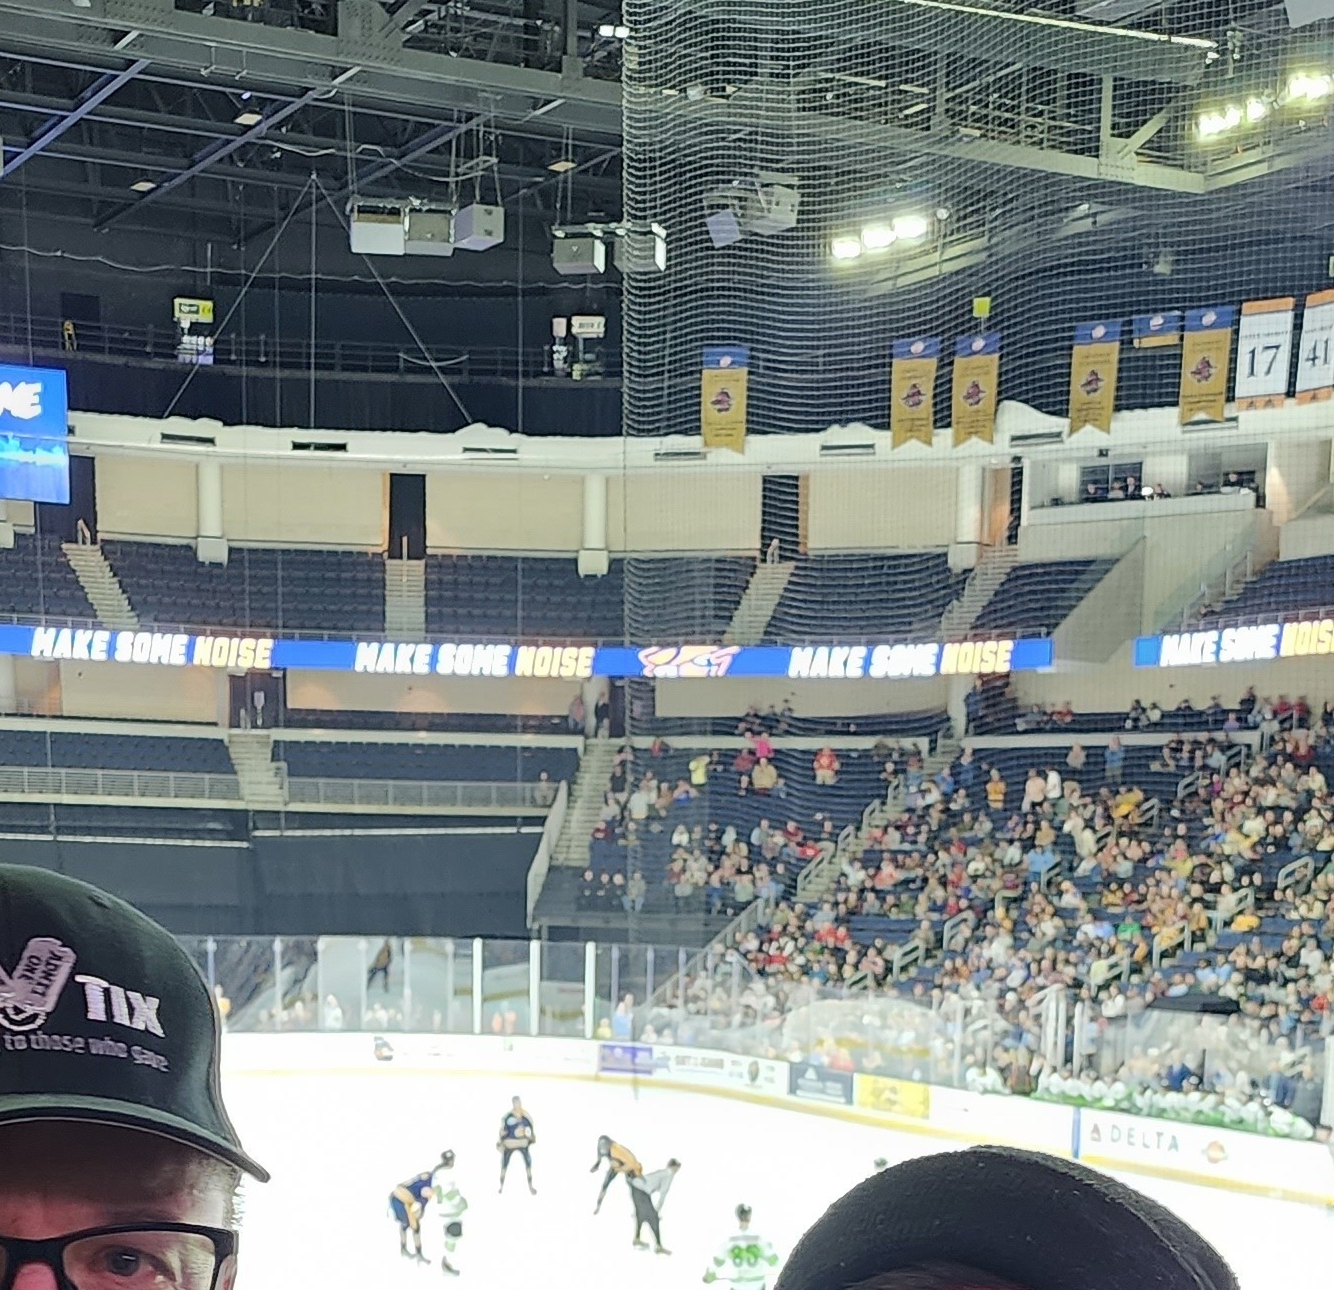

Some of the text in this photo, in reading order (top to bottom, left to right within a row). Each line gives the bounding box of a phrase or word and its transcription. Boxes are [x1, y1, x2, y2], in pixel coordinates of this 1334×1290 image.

[1246, 343, 1281, 379] 17
[1304, 338, 1330, 368] 41
[30, 627, 274, 668] MAKE SOME NOISE
[355, 642, 595, 677] MAKE SOME NOISE
[788, 640, 1014, 678] MAKE SOME NOISE
[1159, 630, 1218, 667] MAKE
[1219, 623, 1280, 662] SOME
[17, 954, 41, 980] ONE
[30, 949, 64, 996] ADMIT
[74, 974, 166, 1038] TIX
[3, 1031, 27, 1050] to
[29, 1030, 85, 1054] those
[88, 1036, 128, 1058] who
[1111, 1124, 1179, 1152] DELTA
